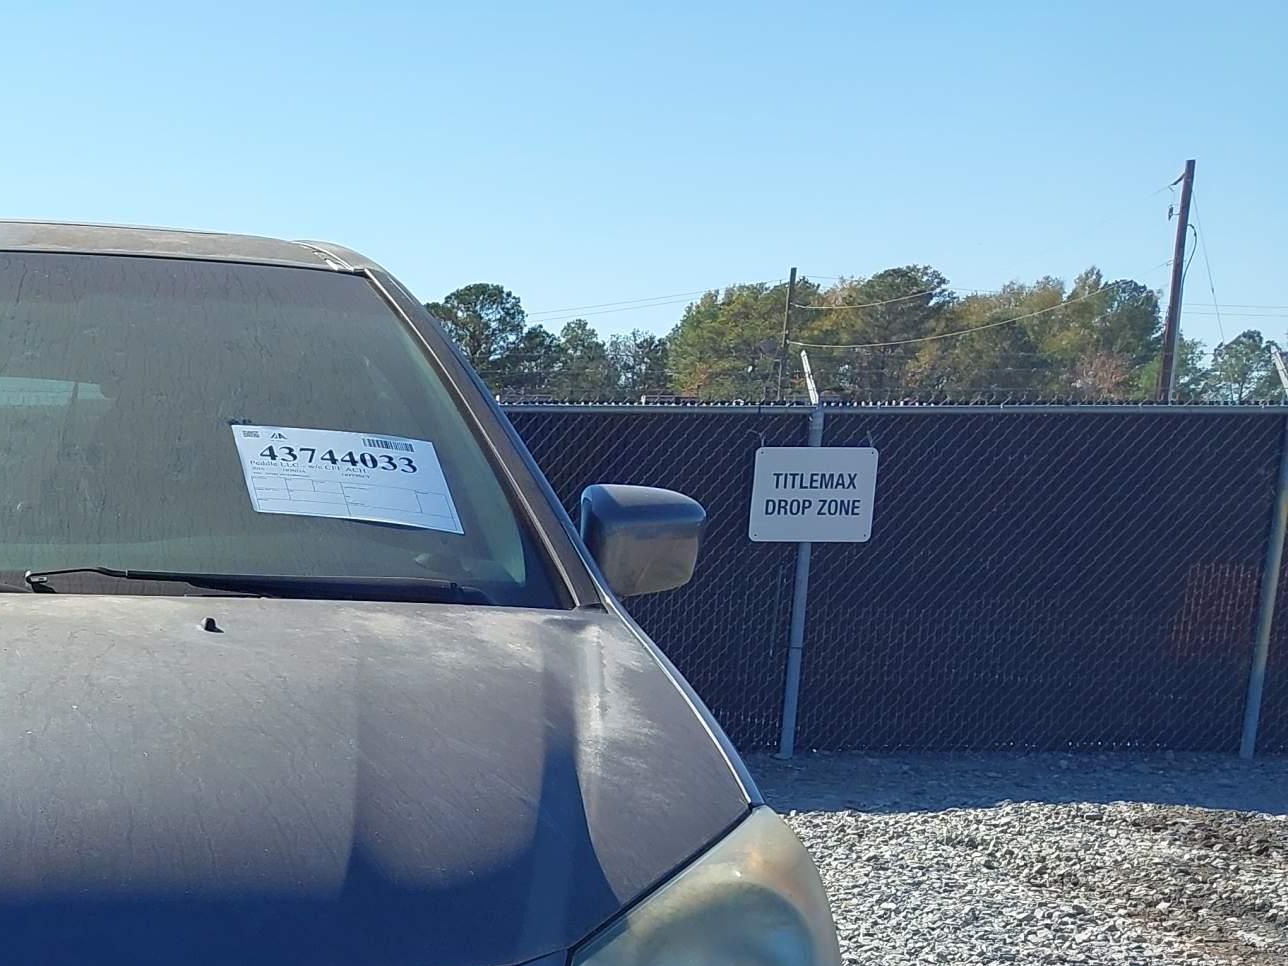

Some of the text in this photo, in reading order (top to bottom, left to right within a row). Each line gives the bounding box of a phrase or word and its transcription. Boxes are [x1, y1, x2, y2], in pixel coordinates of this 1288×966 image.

[259, 445, 418, 474] 43744033
[772, 473, 858, 489] TITLEMAX
[765, 500, 861, 516] DROP ZONE
